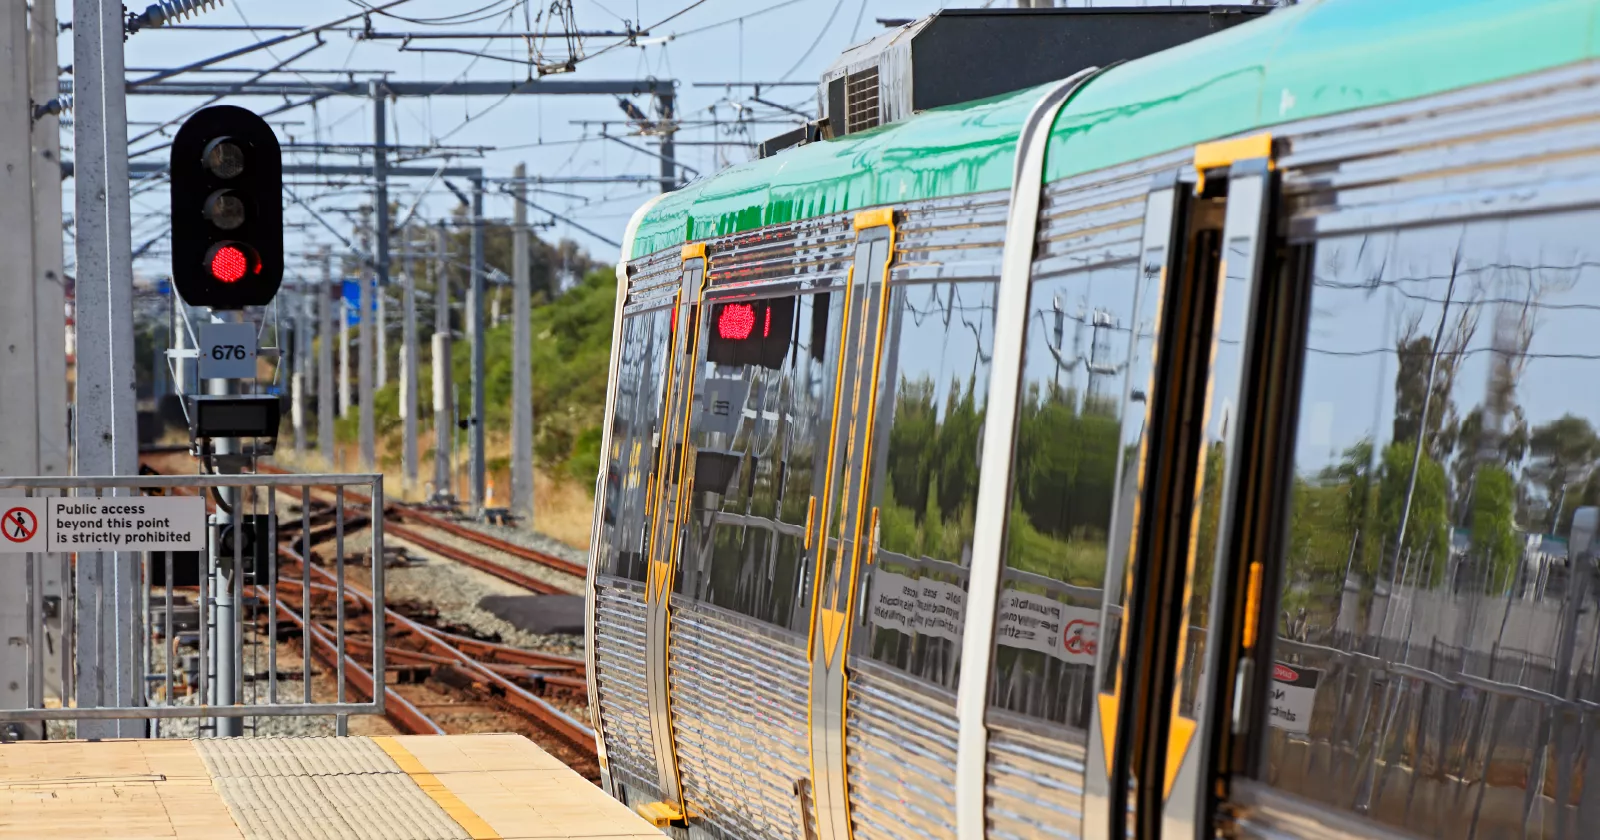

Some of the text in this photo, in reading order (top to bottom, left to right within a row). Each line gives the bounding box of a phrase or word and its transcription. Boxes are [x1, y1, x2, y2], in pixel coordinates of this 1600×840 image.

[212, 345, 246, 360] 676
[56, 504, 145, 514] Public access
[56, 518, 170, 530] beyond this point
[56, 532, 191, 545] is strictly prohibited
